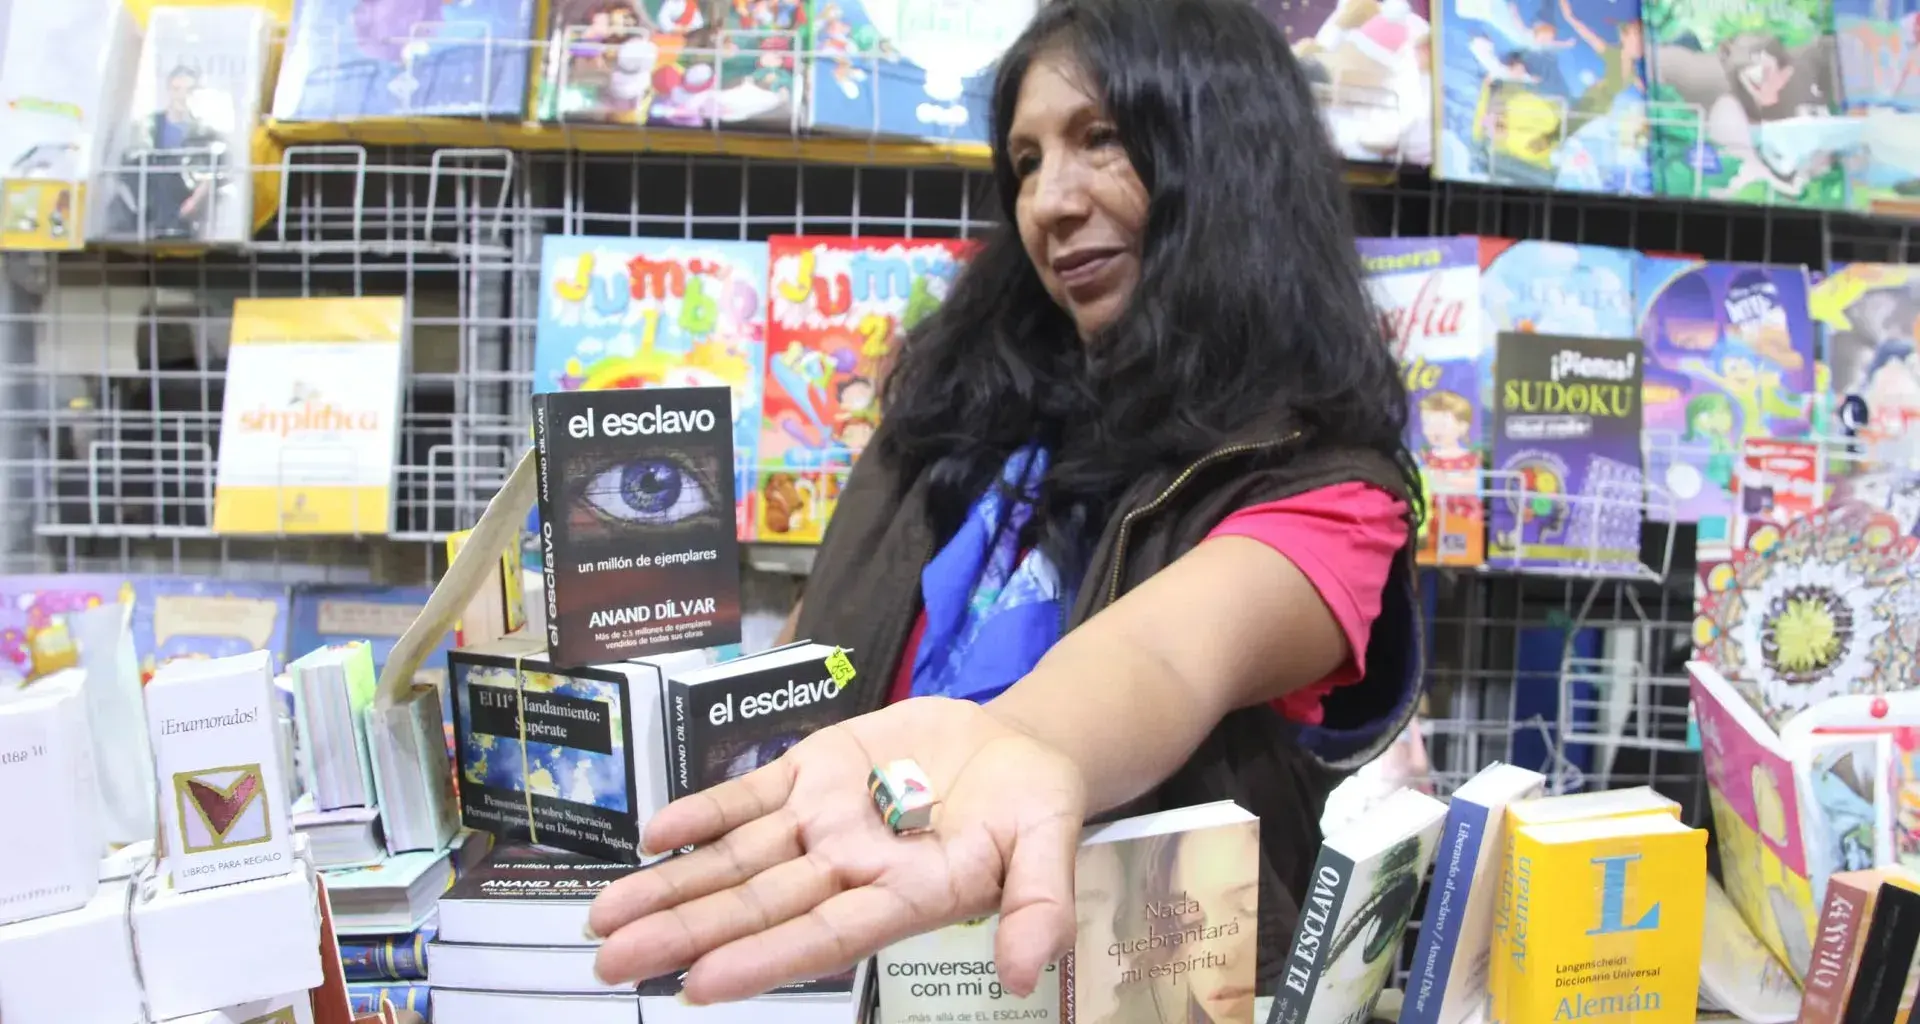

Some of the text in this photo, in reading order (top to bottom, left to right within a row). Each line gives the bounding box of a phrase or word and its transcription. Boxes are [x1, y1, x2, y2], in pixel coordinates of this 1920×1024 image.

[555, 251, 758, 335] Jumbo
[778, 248, 942, 331] Jumb
[861, 314, 891, 356] 2
[1503, 379, 1634, 416] SUDOKU
[568, 404, 716, 439] el esclavo
[541, 455, 549, 502] ANAND
[578, 549, 717, 574] un millón de ejemplares
[543, 521, 558, 646] el esclavo
[588, 597, 716, 629] ANAND DÍLVAR
[595, 630, 610, 642] Más
[611, 629, 621, 640] de
[634, 625, 664, 638] millones
[664, 623, 674, 634] de
[675, 619, 712, 633] ejemplares
[605, 629, 703, 650] vendidos de todas sus obras
[479, 690, 493, 706] El
[709, 679, 840, 726] el esclavo
[160, 706, 260, 736] ¡Enamorados!
[675, 695, 690, 789] ANAND DÍLVAR
[466, 804, 634, 851] Personal inspiraos en Dios y sus Ángeles
[484, 794, 612, 831] Pensamiens sobre Superación
[182, 852, 282, 878] LIBROS PARA REGALO
[512, 862, 550, 870] millón
[1449, 821, 1470, 878] Liberando
[480, 878, 617, 889] ANAND DÍLVA
[1445, 878, 1456, 891] al
[1585, 853, 1660, 935] L
[1145, 890, 1200, 920] Nada
[1436, 890, 1451, 930] esclavo
[1511, 856, 1531, 975] Alemán
[1108, 916, 1240, 966] quebrantará
[1286, 864, 1341, 996] EL ESCLAVO
[887, 958, 1056, 977] conversacs
[1121, 950, 1226, 986] mi espíritu
[1424, 940, 1441, 979] Anand
[1555, 955, 1628, 974] Langenscheidt
[1555, 966, 1661, 988] Diccionario Universal
[911, 981, 950, 997] con
[957, 978, 982, 996] mi
[1066, 979, 1075, 1024] NAND
[1553, 985, 1662, 1021] Alemán
[936, 1008, 954, 1022] allá
[957, 1009, 972, 1022] de
[975, 1009, 990, 1022] EL
[993, 1008, 1048, 1021] ESCLAVO
